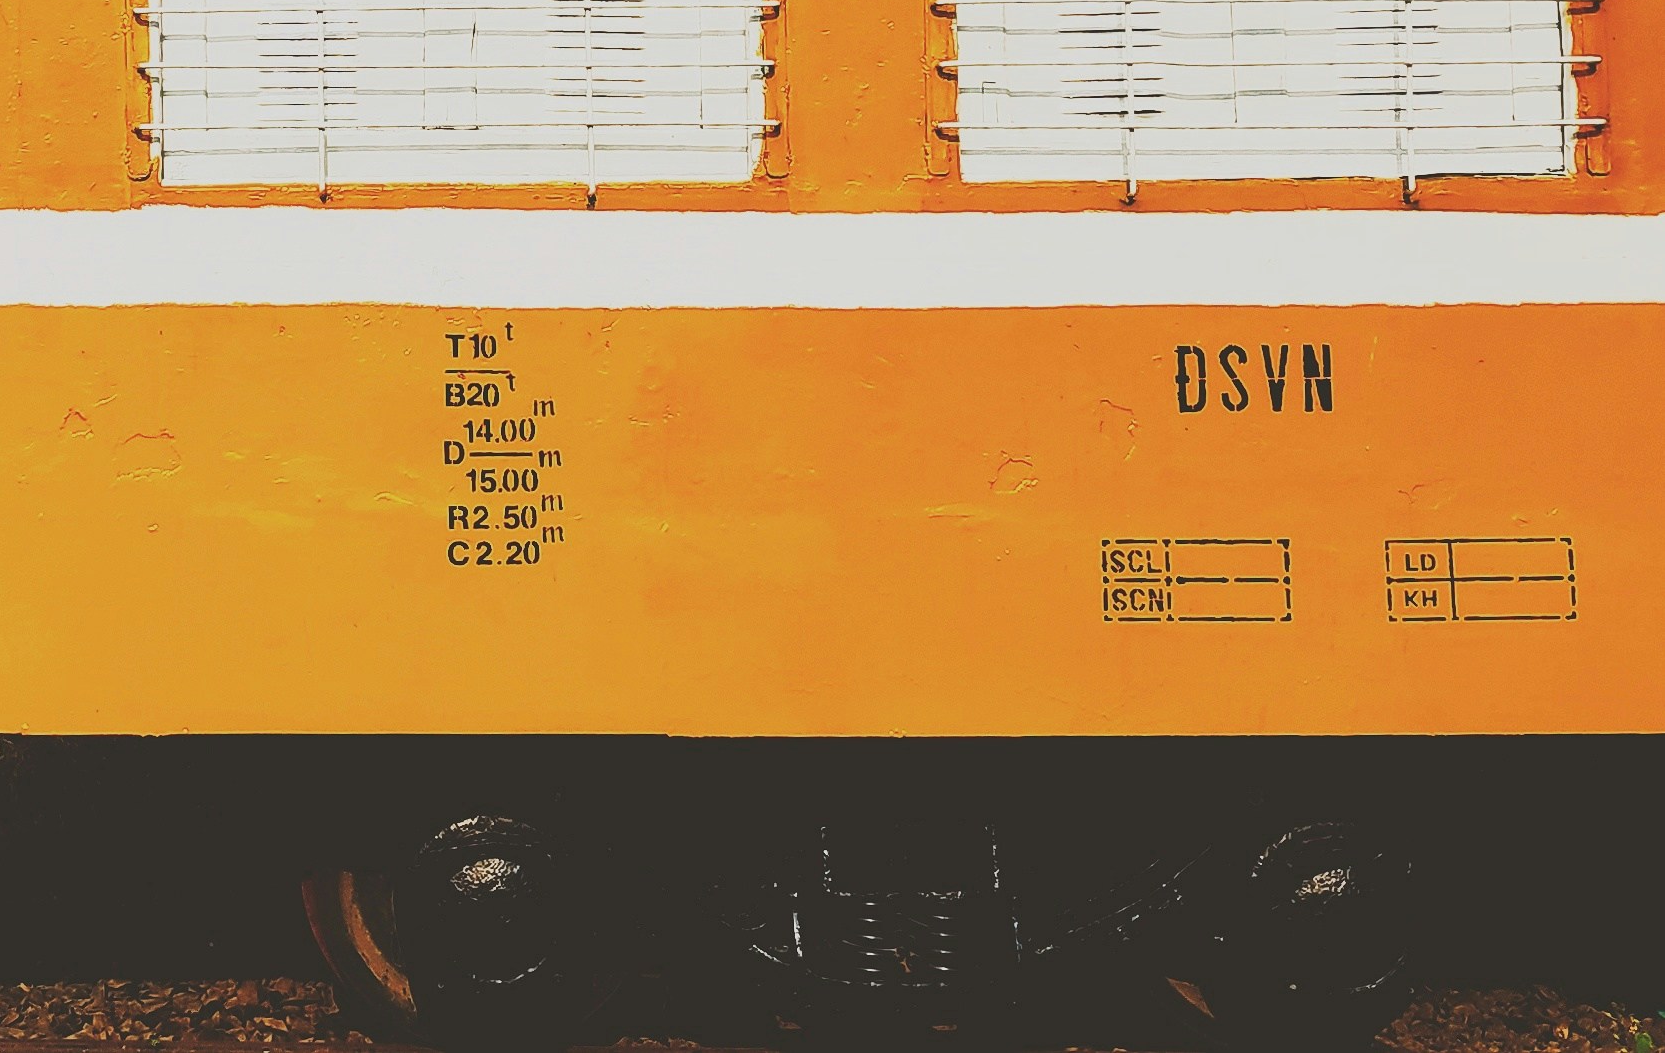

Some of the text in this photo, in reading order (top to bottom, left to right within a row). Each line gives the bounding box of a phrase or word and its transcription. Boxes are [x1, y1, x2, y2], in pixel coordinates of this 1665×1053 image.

[443, 440, 465, 465] D
[1109, 549, 1163, 574] SCL
[1404, 553, 1437, 572] LD
[1111, 588, 1165, 613] SCN
[1404, 589, 1438, 608] KH
